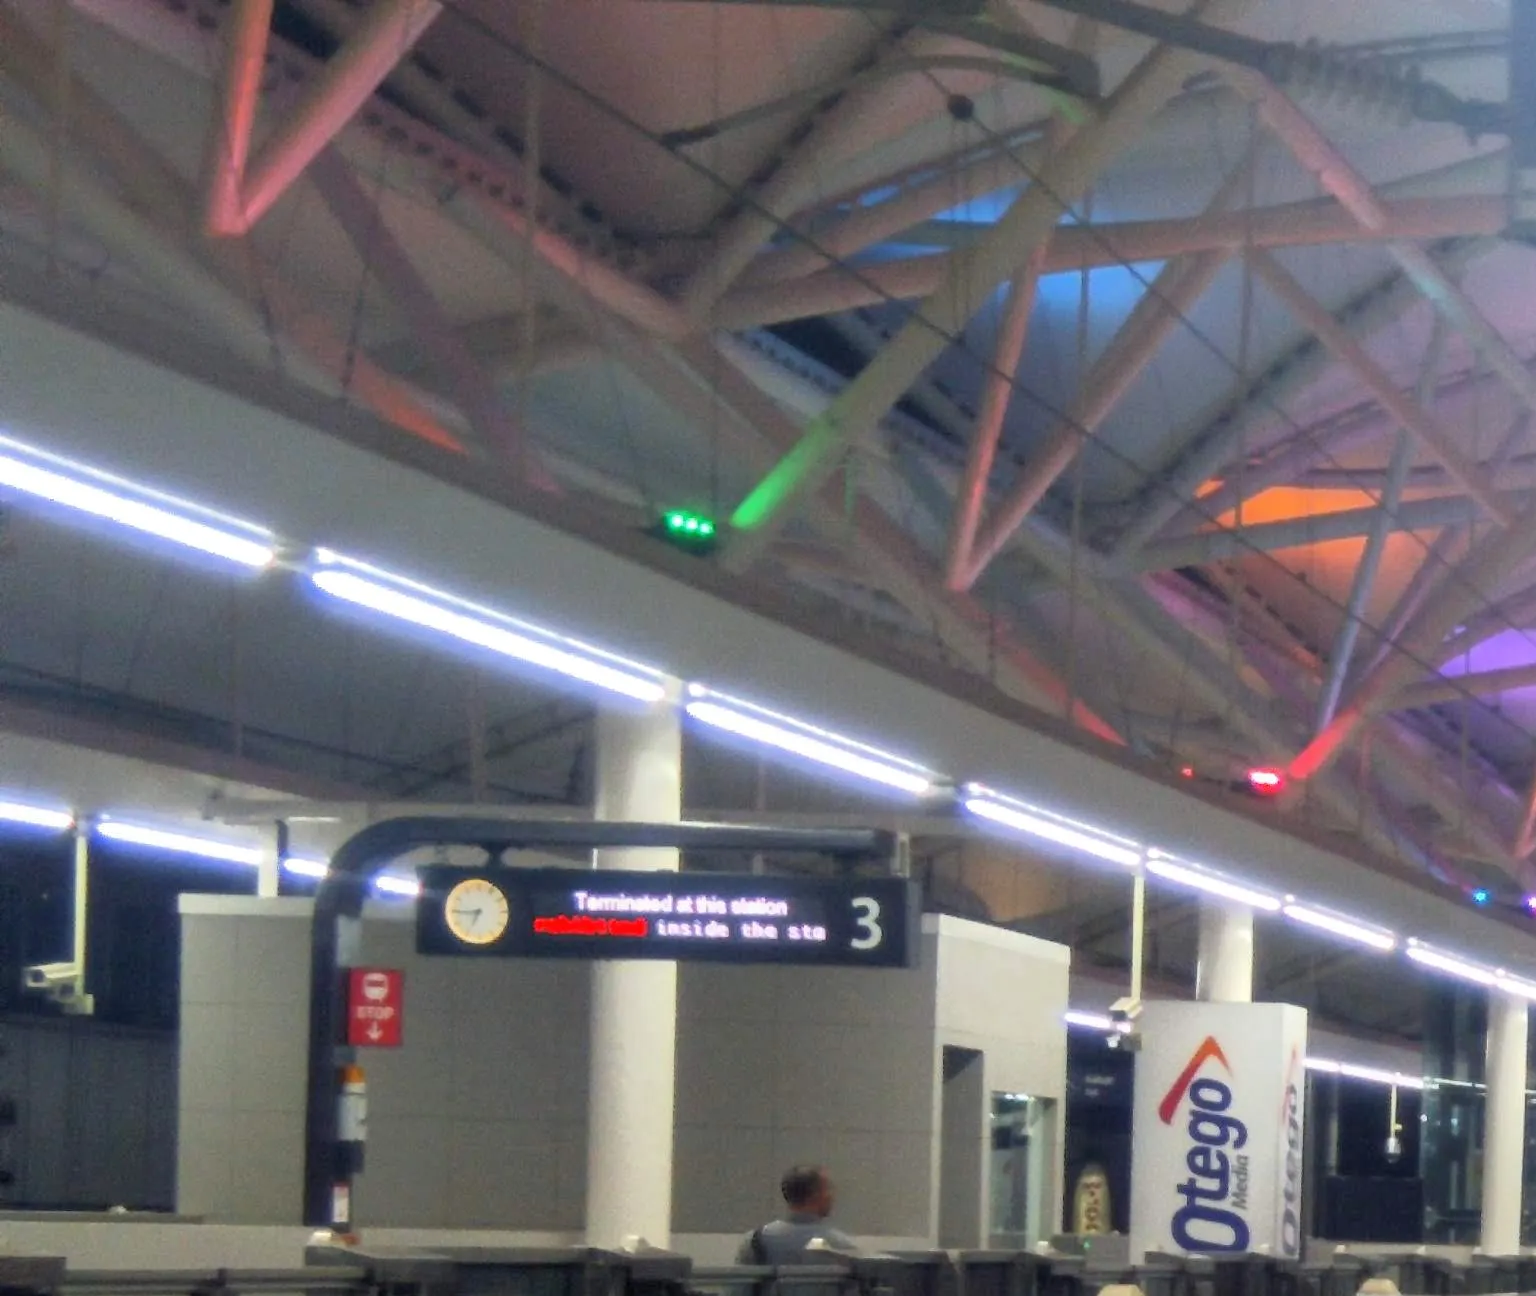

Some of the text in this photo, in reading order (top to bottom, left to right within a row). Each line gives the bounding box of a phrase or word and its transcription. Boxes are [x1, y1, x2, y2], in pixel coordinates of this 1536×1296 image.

[574, 890, 788, 916] Terminated at this station
[850, 896, 884, 950] 3
[656, 918, 729, 938] inside
[741, 919, 778, 939] the
[788, 922, 826, 941] sta
[357, 1005, 395, 1020] STOP
[1171, 1077, 1250, 1254] Otego
[1230, 1154, 1250, 1210] Media
